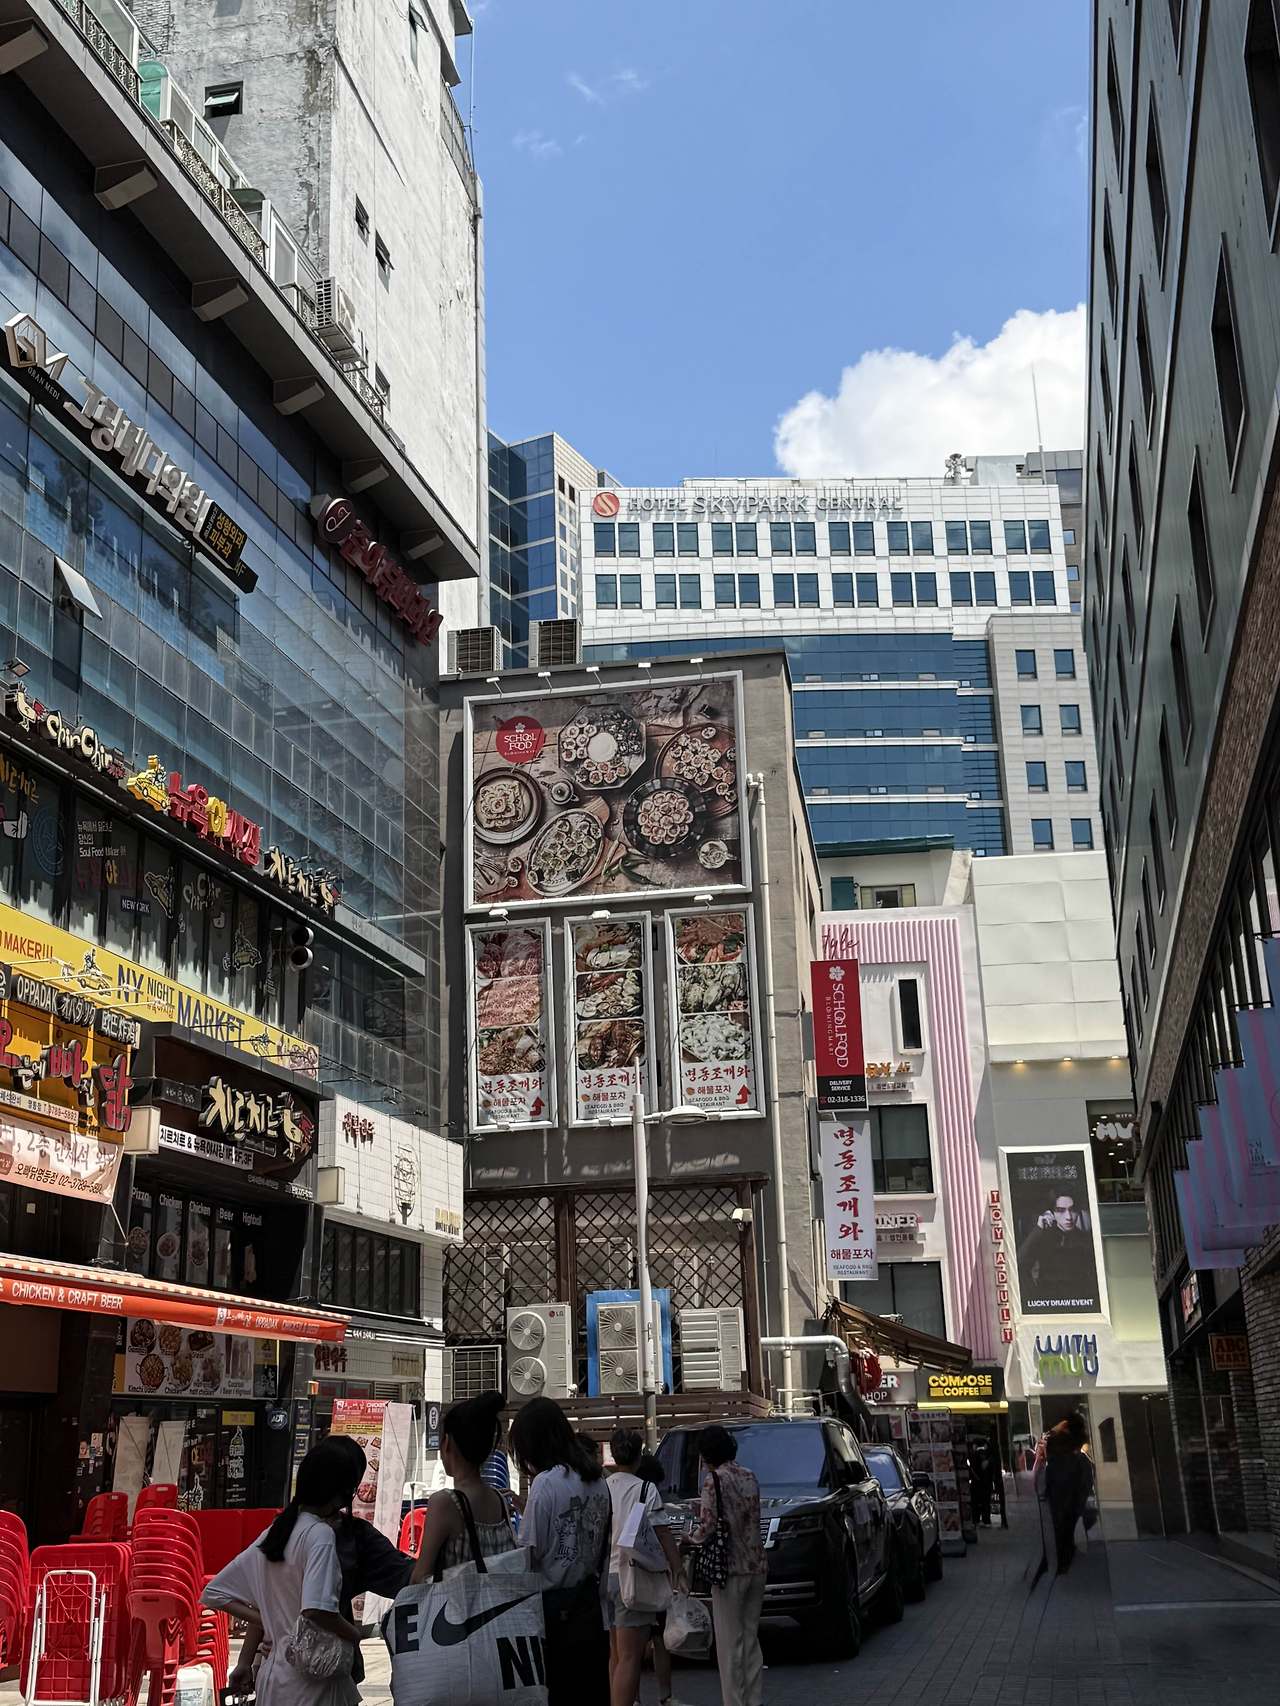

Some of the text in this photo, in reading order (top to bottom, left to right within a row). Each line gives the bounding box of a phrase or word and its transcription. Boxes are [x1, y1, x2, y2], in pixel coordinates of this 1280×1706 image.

[628, 495, 904, 513] HOTEL SKYPARK CENTRAL
[217, 512, 245, 549] 성형외과
[209, 528, 233, 559] 피부과
[504, 732, 537, 743] SCHOOL
[508, 741, 533, 751] FOOD
[121, 898, 135, 910] NEW
[16, 975, 59, 1012] OPPADAK
[117, 964, 245, 1050] NY NIGHT MARKET
[685, 1065, 751, 1082] 명동조개와
[160, 1126, 186, 1147] 치르치르
[187, 1137, 192, 1149] &
[193, 1137, 224, 1160] 뉴욕야시장
[132, 1187, 150, 1202] Pizza
[159, 1192, 183, 1209] Chicken
[189, 1199, 211, 1216] Chicken
[219, 1207, 235, 1221] Beer
[830, 1249, 874, 1261] 해물포차
[989, 1190, 1013, 1344] TOY ADULT
[11, 1282, 124, 1310] CHICKEN & CRAFT BEER
[1071, 1298, 1094, 1306] EVENT
[1035, 1333, 1098, 1355] WITH
[1215, 1337, 1246, 1352] ABC
[1215, 1352, 1248, 1363] MART
[928, 1374, 993, 1387] COMPOSE
[943, 1387, 980, 1397] COFFEE
